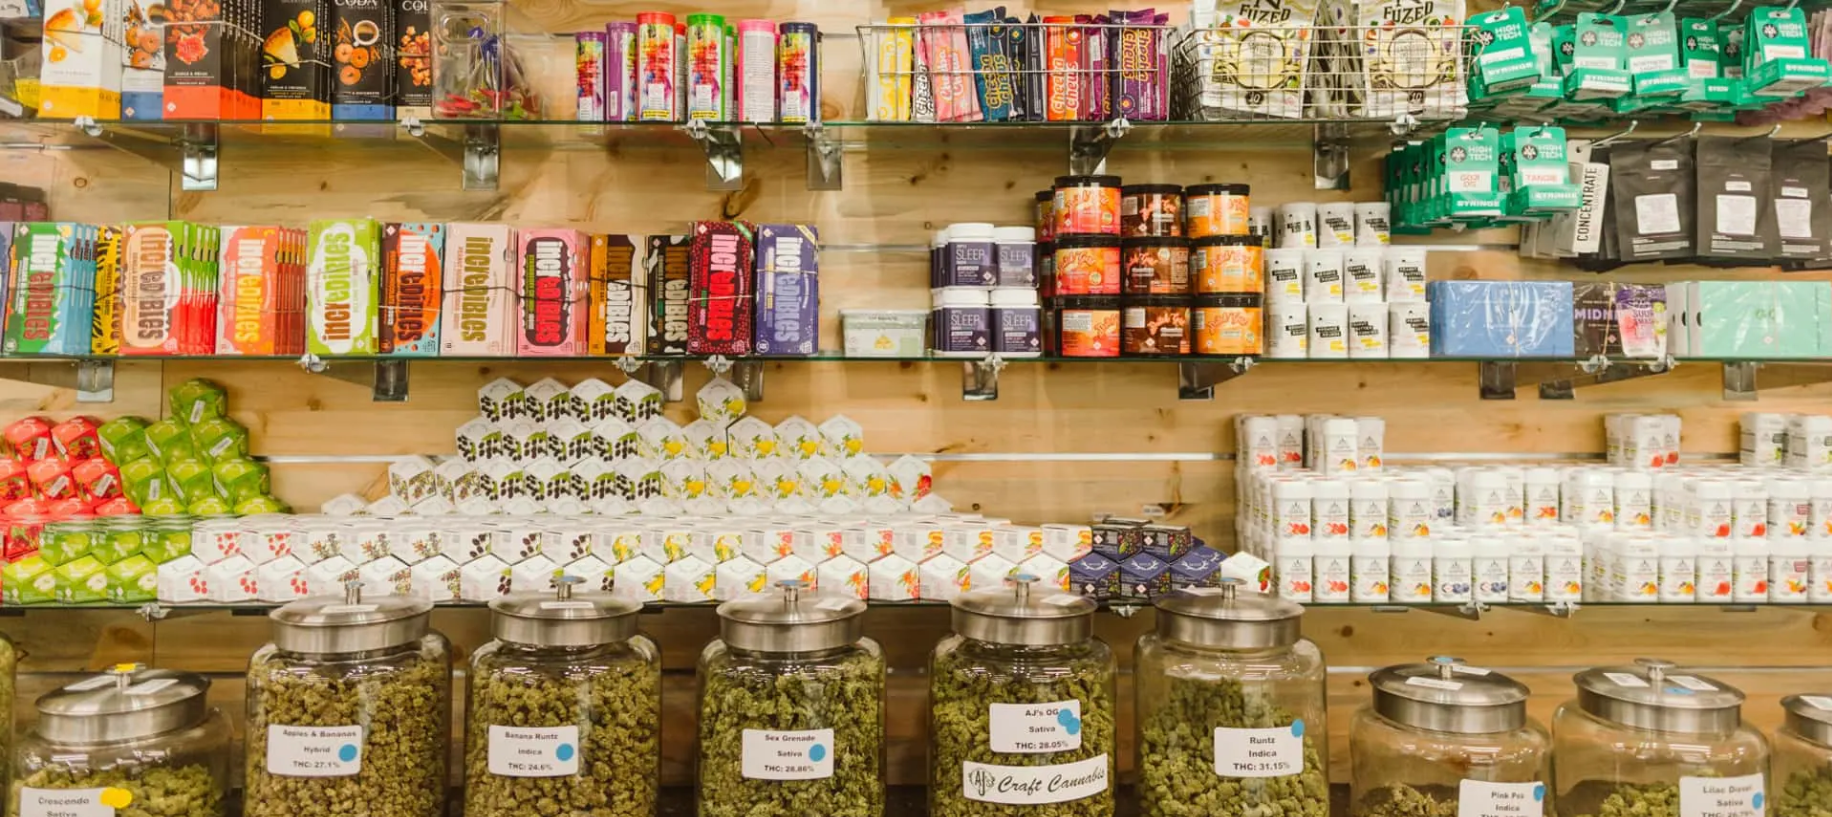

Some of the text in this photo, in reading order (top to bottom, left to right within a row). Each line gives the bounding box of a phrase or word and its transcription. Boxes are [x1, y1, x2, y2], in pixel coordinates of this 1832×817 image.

[1576, 167, 1598, 242] CONCENTRATE
[956, 248, 985, 261] SLEEP
[950, 314, 980, 326] SLEEP
[1003, 314, 1032, 326] SLEEP
[1025, 709, 1044, 717] AJ's
[283, 729, 309, 738] Apples
[1028, 725, 1056, 733] Sativa
[505, 731, 534, 740] Banana
[1249, 736, 1276, 744] Runtz
[303, 746, 331, 755] Hybrid
[518, 748, 543, 756] Indica
[1248, 750, 1277, 758] Indica
[508, 762, 527, 770] THC:
[1233, 763, 1257, 771] THC:
[997, 775, 1042, 796] Craft
[1047, 765, 1105, 793] Cannabis
[1703, 785, 1726, 794] Lilac
[1491, 791, 1509, 799] Pink
[38, 796, 90, 805] Crescendo
